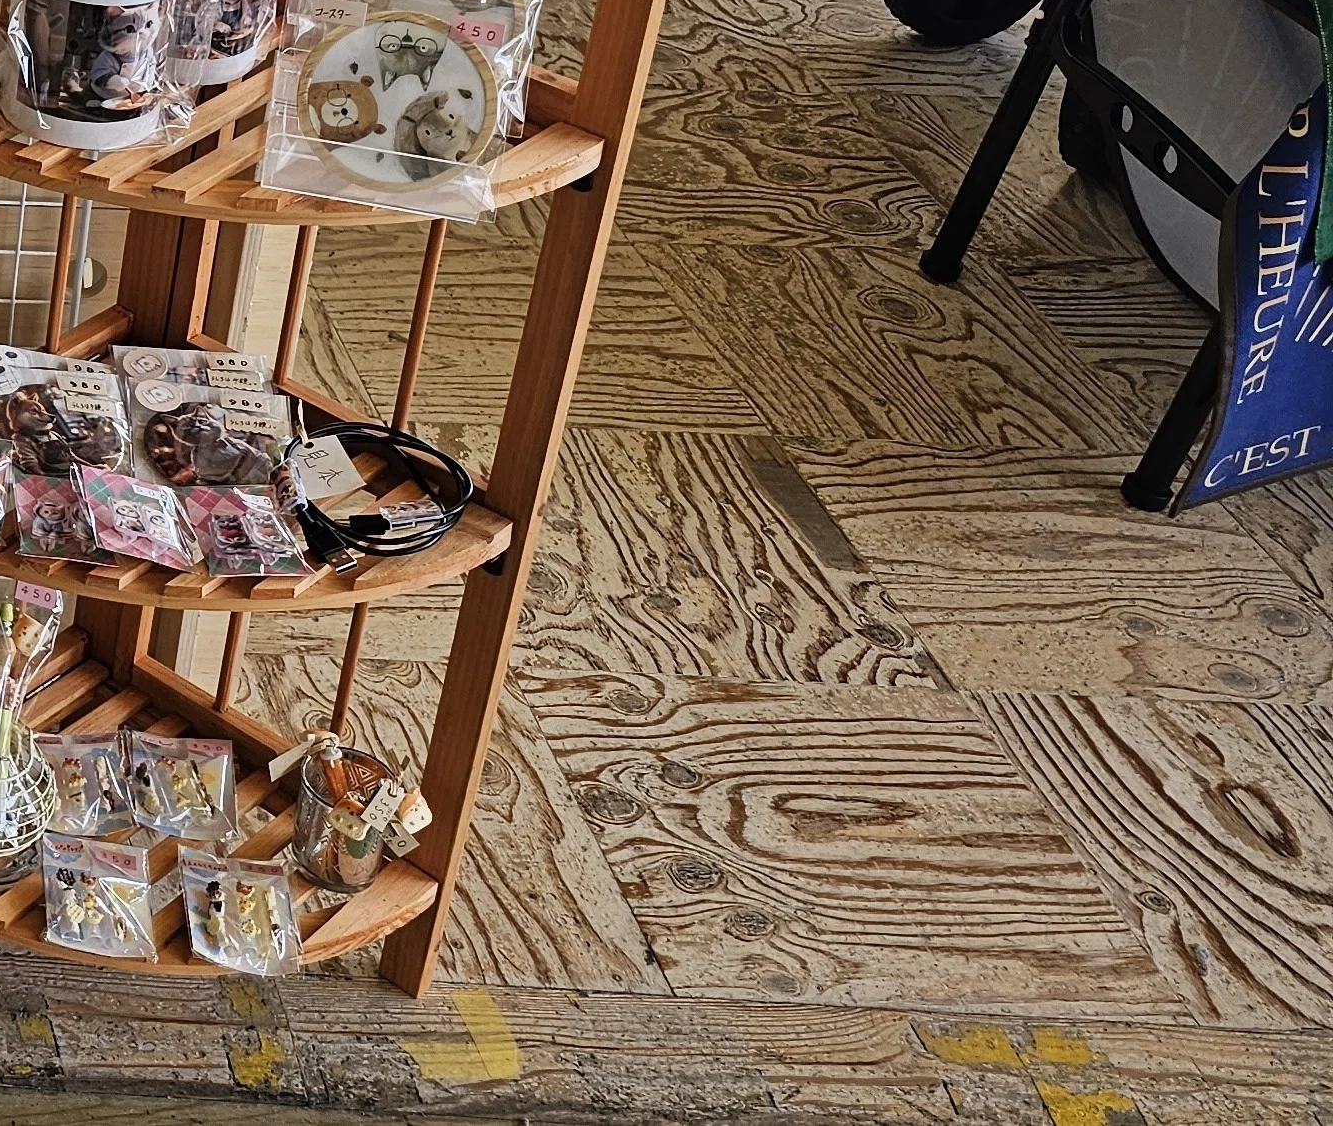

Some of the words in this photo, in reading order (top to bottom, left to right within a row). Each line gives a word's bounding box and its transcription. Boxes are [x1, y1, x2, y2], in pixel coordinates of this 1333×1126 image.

[456, 22, 496, 41] 450
[1237, 164, 1309, 405] L'HEURE
[297, 449, 344, 487] 見本
[1204, 424, 1322, 488] C'EST
[21, 585, 52, 603] 450
